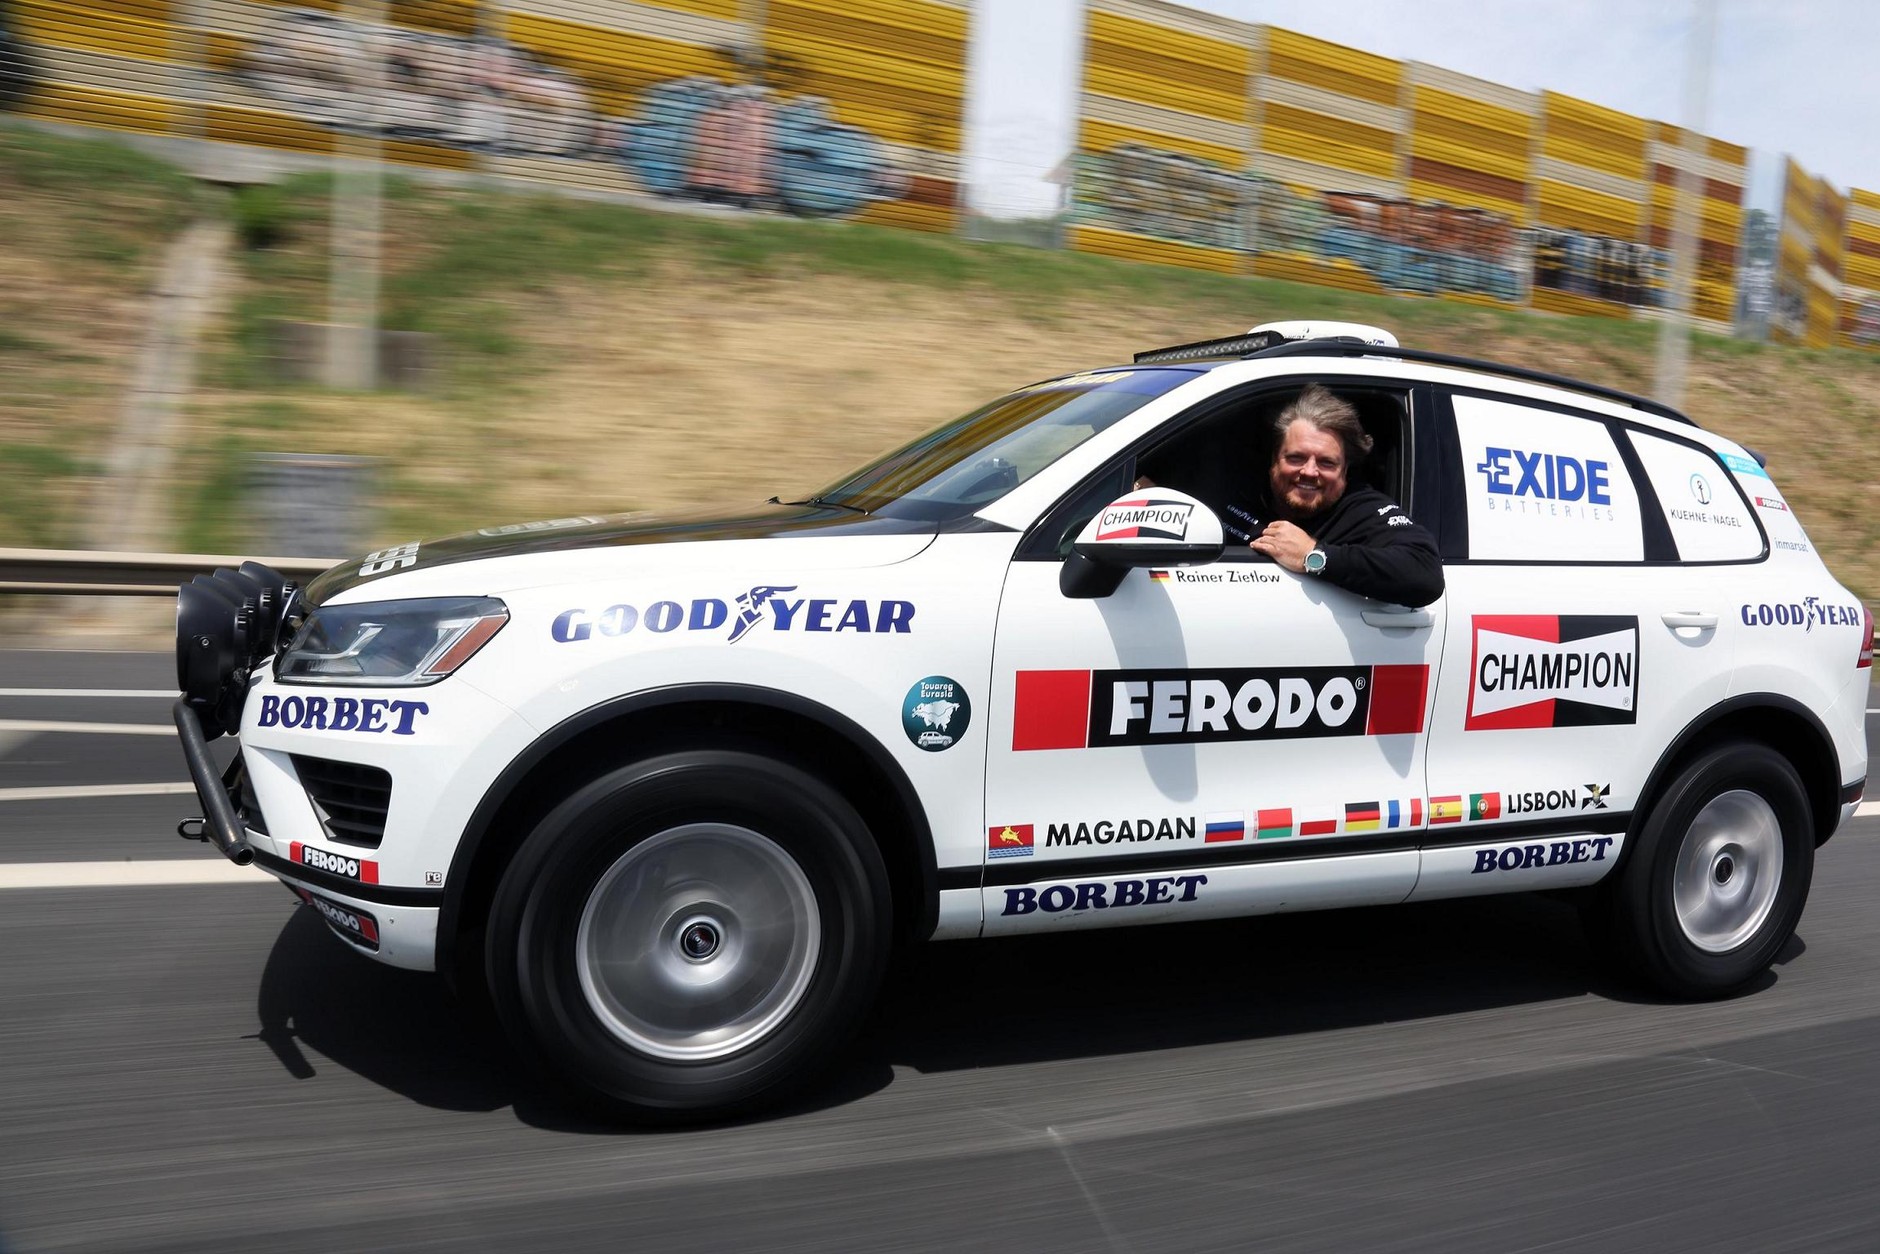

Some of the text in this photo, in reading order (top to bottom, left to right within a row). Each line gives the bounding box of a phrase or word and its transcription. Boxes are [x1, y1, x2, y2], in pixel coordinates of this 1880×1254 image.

[1477, 447, 1611, 505] EXIDE
[1103, 509, 1186, 526] CHAMPION
[1488, 497, 1614, 521] BATTERIES
[1773, 537, 1809, 553] inmarsat
[1176, 570, 1281, 583] Rainer Zietlow
[920, 682, 954, 691] Touareg
[1479, 652, 1632, 693] CHAMPION
[920, 689, 953, 698] Eurasia
[1109, 676, 1359, 736] FERODO
[257, 695, 430, 736] BORBET
[1045, 788, 1577, 848] MAGADAN LISBON
[304, 846, 359, 878] FERODO
[1471, 836, 1614, 874] BORBET
[1001, 874, 1208, 917] BORBET
